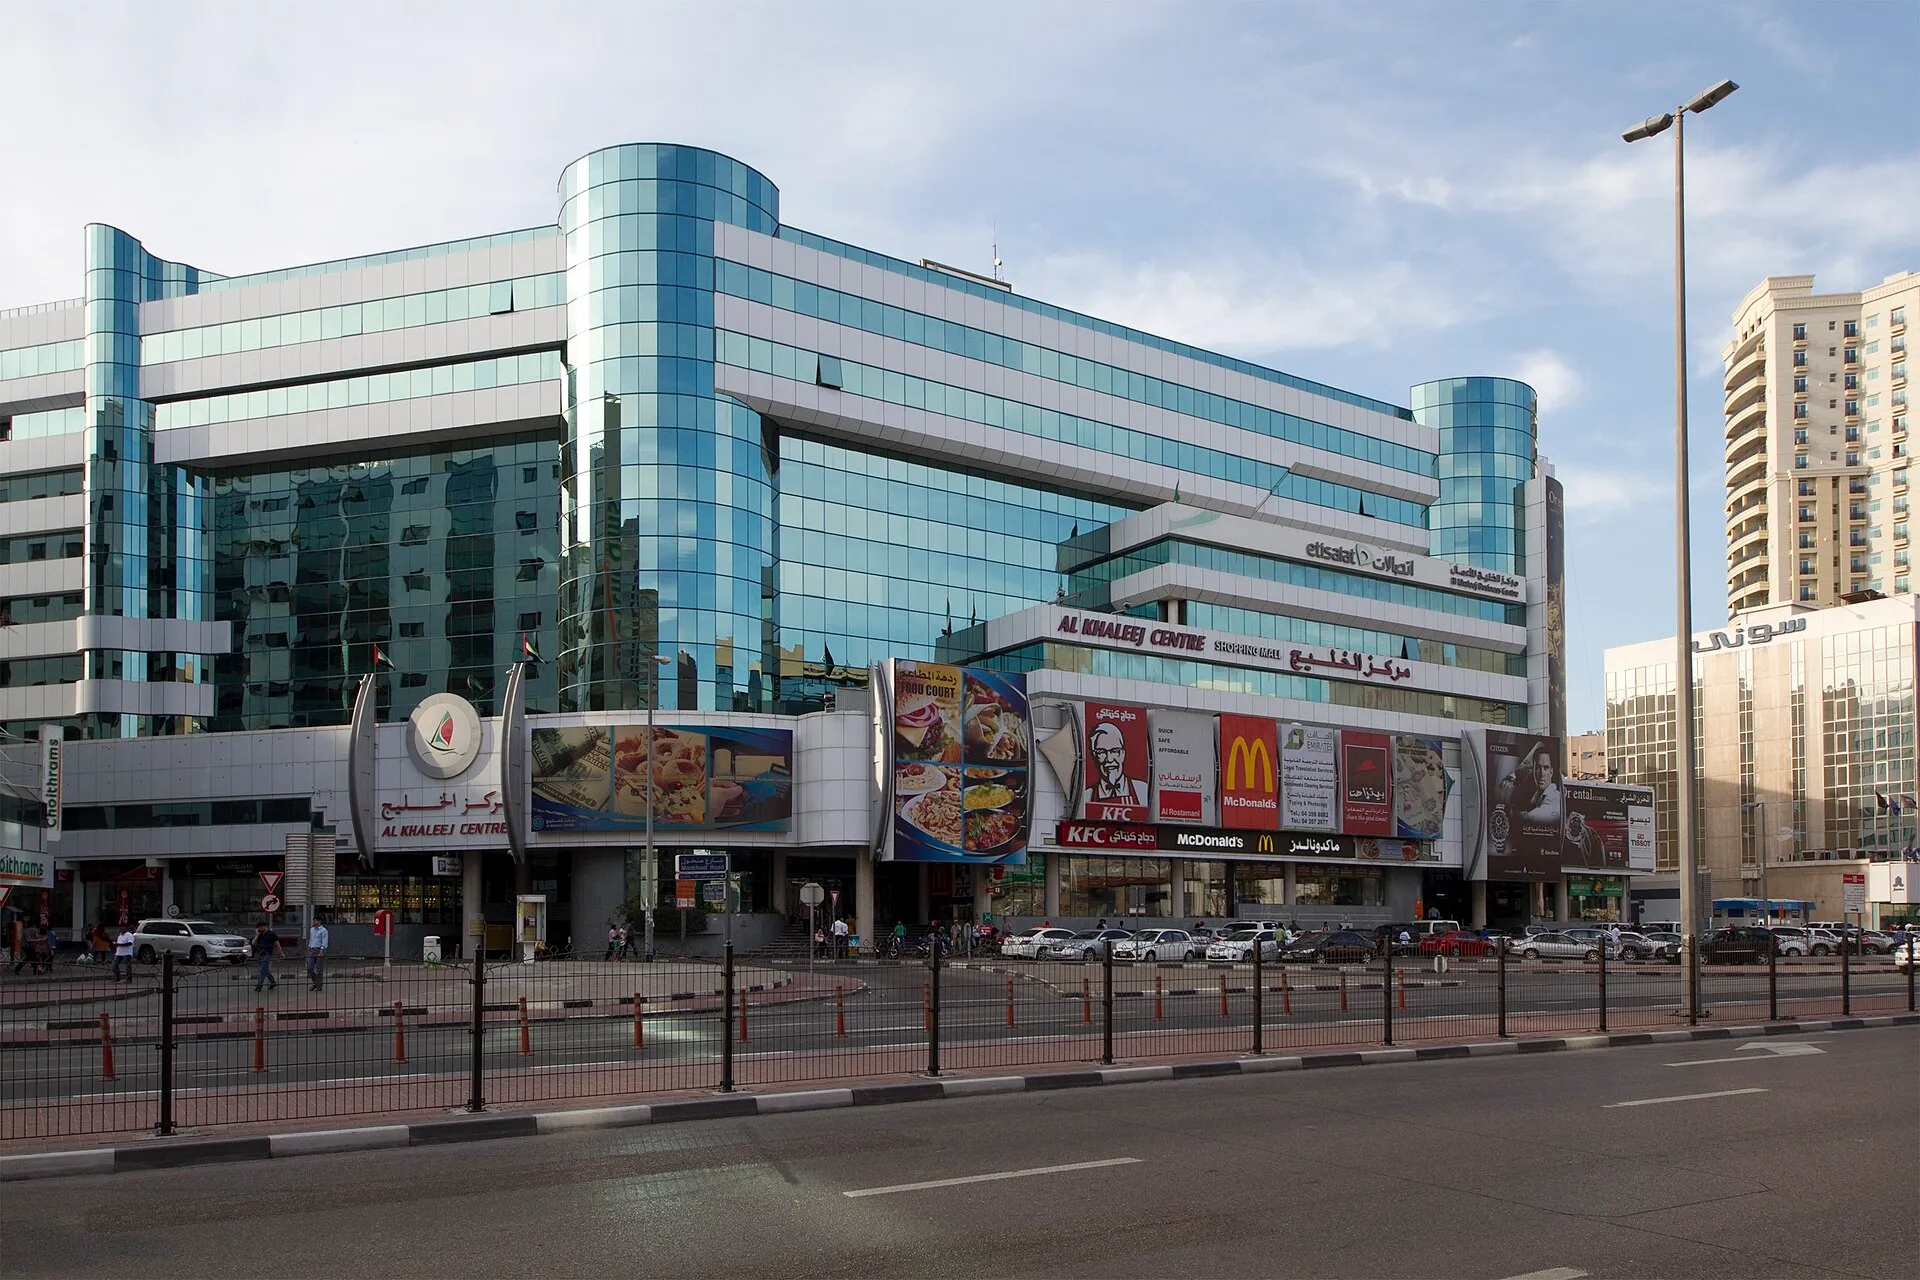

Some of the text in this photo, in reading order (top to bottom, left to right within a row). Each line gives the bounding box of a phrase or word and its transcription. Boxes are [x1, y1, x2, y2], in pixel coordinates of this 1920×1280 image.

[1306, 541, 1356, 565] etisalat
[1372, 556, 1414, 576] اتصالات
[1058, 615, 1282, 660] AL KHALEEJ CENTRE SHOPPING MALL
[1290, 649, 1410, 681] مركز الخليج
[936, 670, 957, 686] ردهة
[901, 682, 955, 698] FOOD COURT
[1096, 708, 1136, 722] دجاج كنتاكي
[1158, 747, 1189, 755] AFFORDABLE
[1307, 740, 1332, 751] EMIRATES
[1489, 745, 1508, 753] CITIZEN
[46, 738, 59, 828] Choithrams
[381, 791, 504, 821] ركز الخليج
[1224, 796, 1277, 809] McDonald's
[1101, 806, 1132, 821] KFC
[1169, 808, 1200, 817] Rostamani
[381, 822, 509, 837] AL KHALEEJ CENTRE
[1067, 826, 1107, 843] KFC
[1109, 830, 1155, 844] دجاج كنتاكي
[1177, 833, 1244, 848] McDonald's
[1289, 838, 1340, 854] ماكدونالدز
